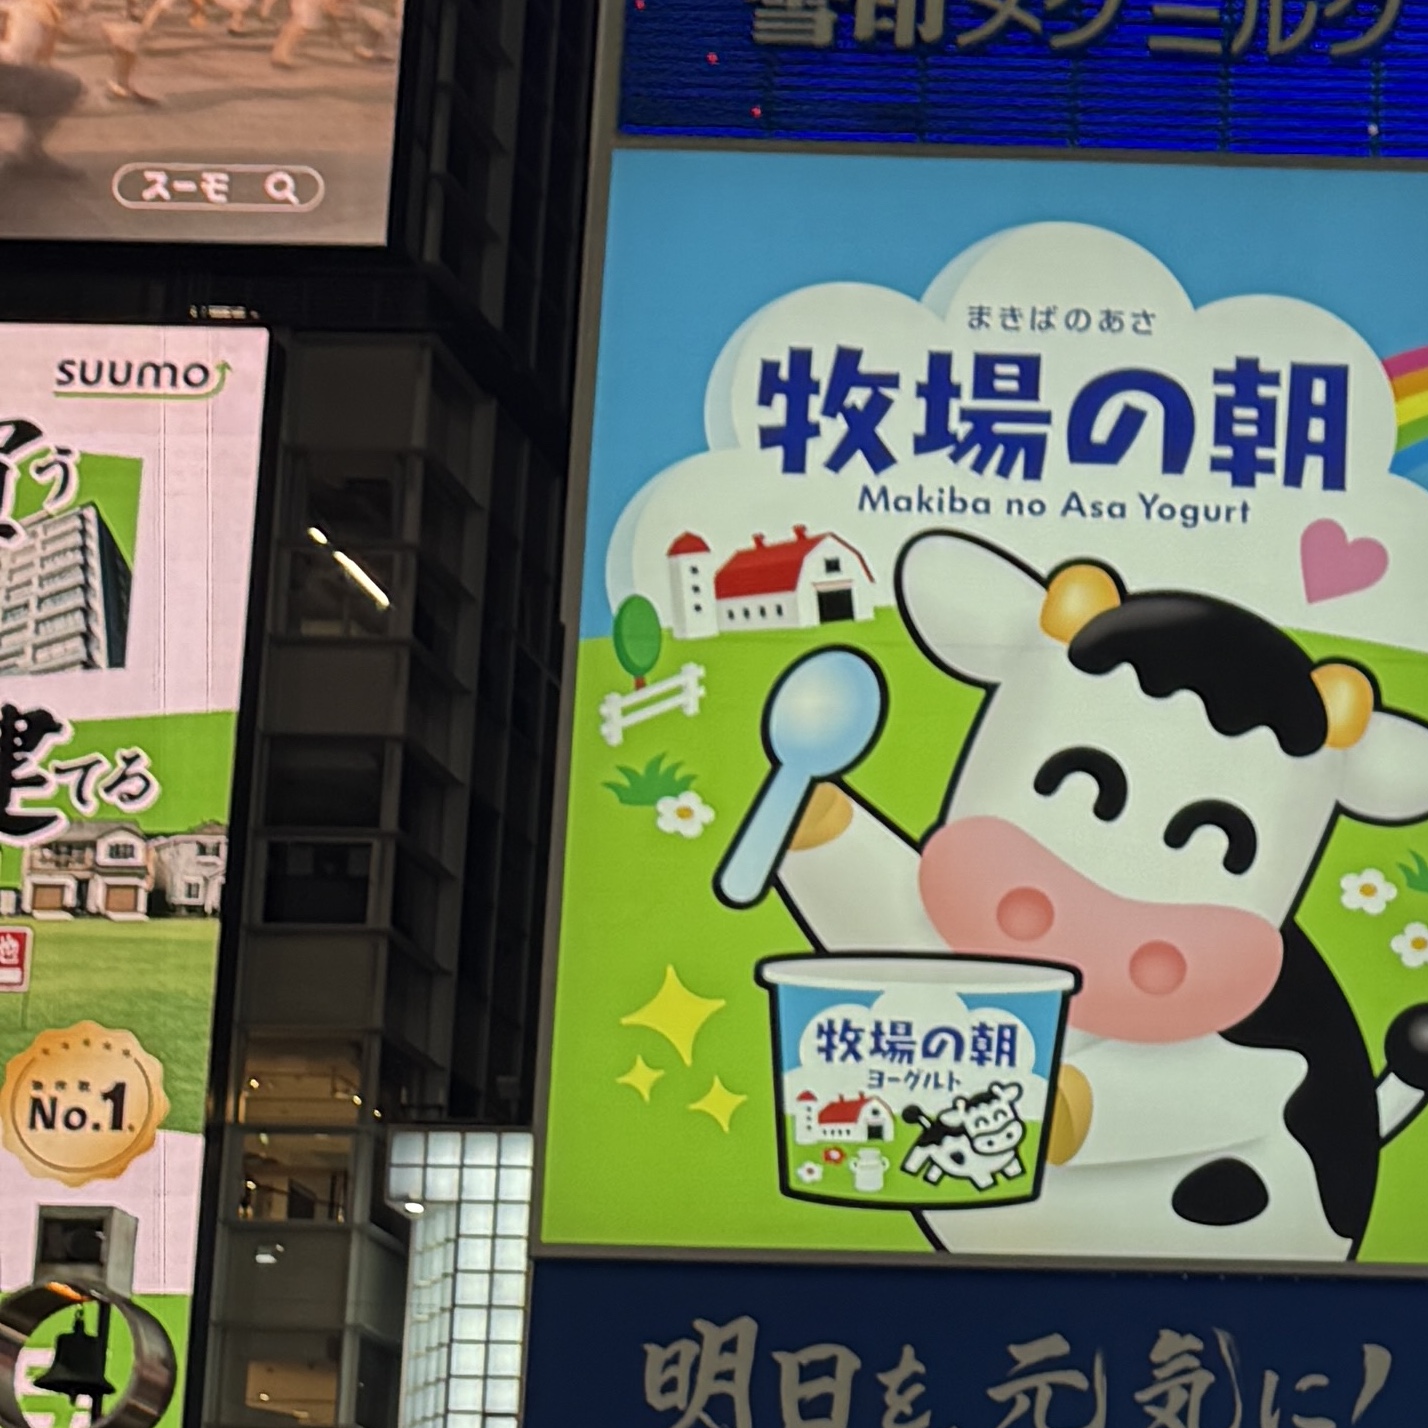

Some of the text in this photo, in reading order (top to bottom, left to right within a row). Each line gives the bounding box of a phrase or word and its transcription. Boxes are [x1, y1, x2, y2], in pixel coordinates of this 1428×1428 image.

[141, 170, 231, 204] スーモ
[965, 304, 1157, 336] まきばのあさ
[757, 346, 1350, 492] 牧場の朝
[857, 485, 1252, 529] Makiba no Asa Yogurt
[815, 1017, 1019, 1067] 牧場の朝
[866, 1067, 963, 1093] ヨーグルト
